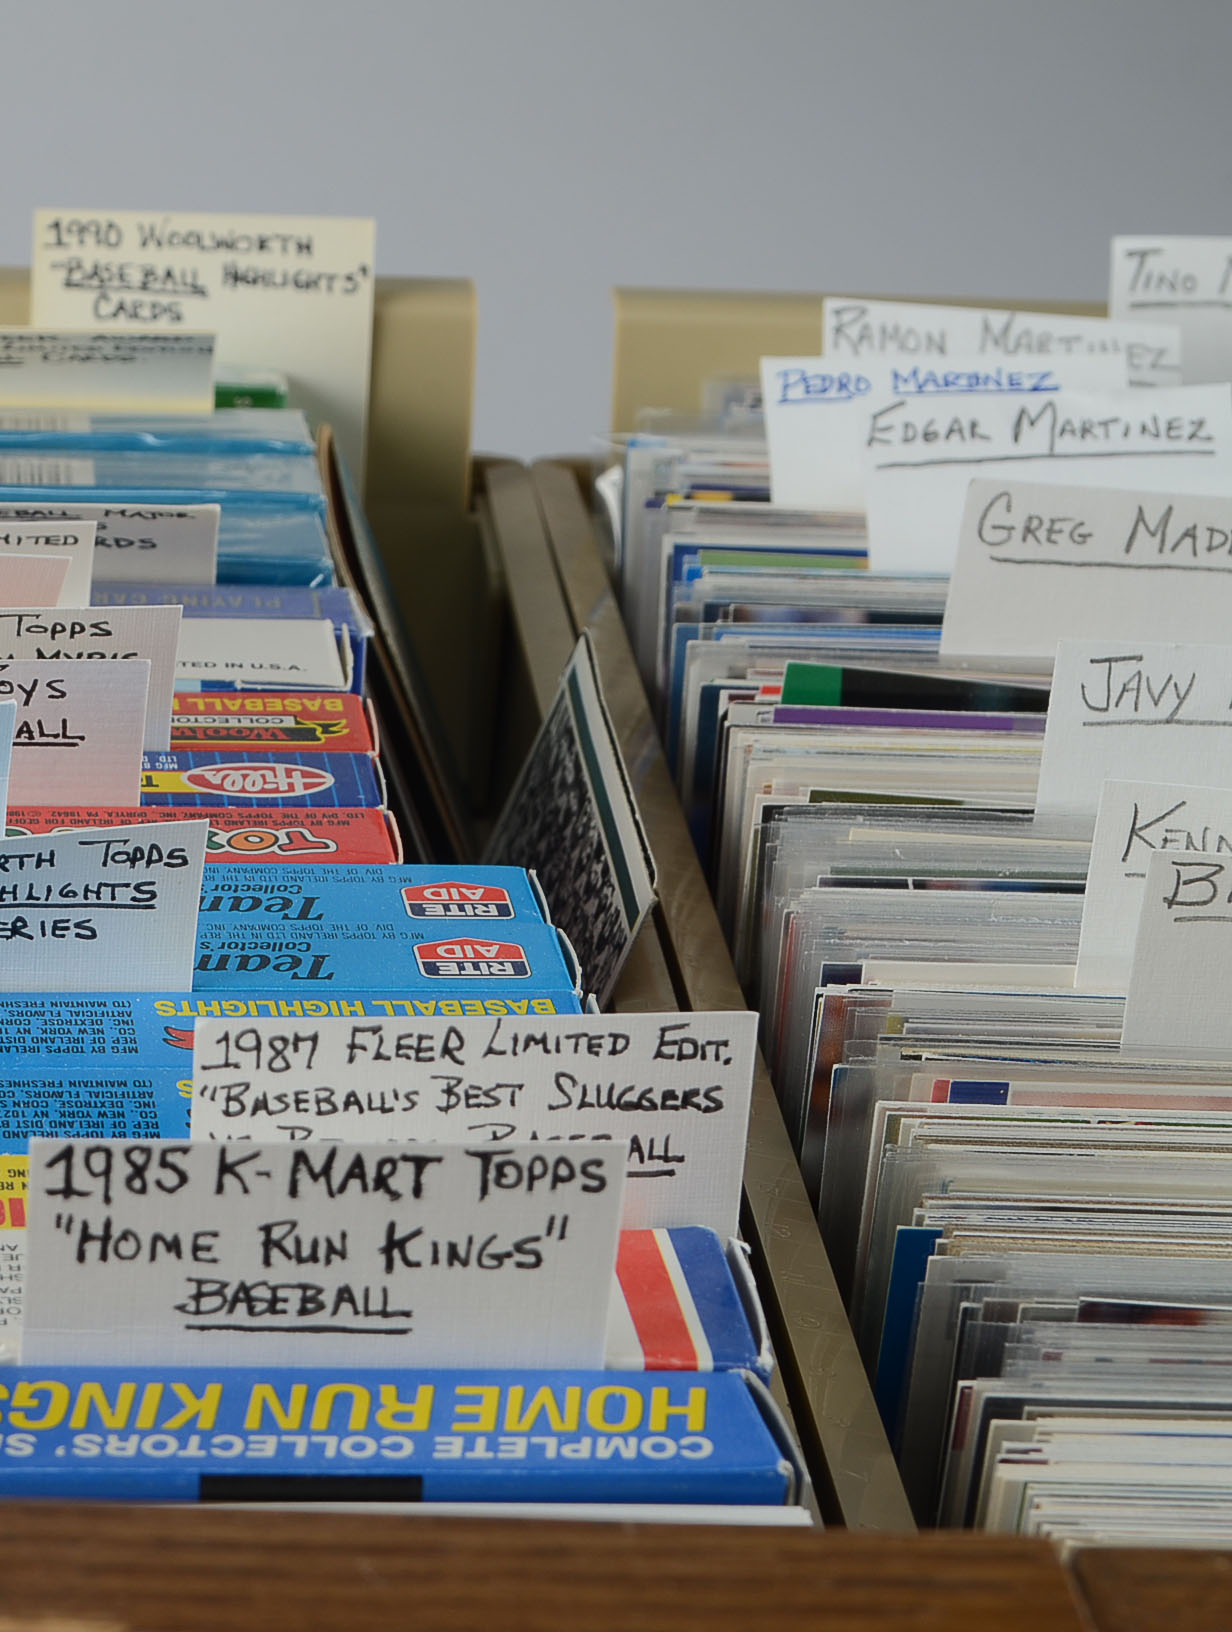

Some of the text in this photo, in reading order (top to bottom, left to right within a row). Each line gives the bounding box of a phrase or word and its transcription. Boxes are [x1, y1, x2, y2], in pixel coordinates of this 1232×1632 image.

[1125, 248, 1198, 294] TINO
[831, 305, 948, 357] RAMON
[777, 369, 872, 398] PEDRO
[867, 400, 1213, 455] EDGAR MARTINEZ
[978, 491, 1232, 558] GREG MAD
[1080, 655, 1196, 721] JAVY
[188, 697, 344, 712] BASEBALL
[171, 715, 285, 725] COLLECTO
[79, 838, 189, 868] TOPPS
[424, 886, 486, 900] AID
[423, 903, 499, 917] RITE
[436, 944, 500, 959] AID
[438, 962, 516, 976] RITE
[154, 997, 557, 1018] BASEBALL HIGHLIGHTS
[47, 1044, 85, 1054] TOPPS
[90, 1044, 105, 1054] BY
[111, 1044, 139, 1054] MFG
[201, 1018, 733, 1074] 1987 FLEER LIMITED EDIT.
[430, 1075, 525, 1114] BEST
[548, 1073, 725, 1114] SLUGGERS
[43, 1146, 190, 1205] 1985
[467, 1149, 608, 1201] TOPPS
[259, 1219, 350, 1268] RUN
[173, 1278, 413, 1319] BASEBALL
[246, 1382, 434, 1433] RUN
[453, 1383, 708, 1433] HOME
[434, 1433, 715, 1461] COMPLETE
